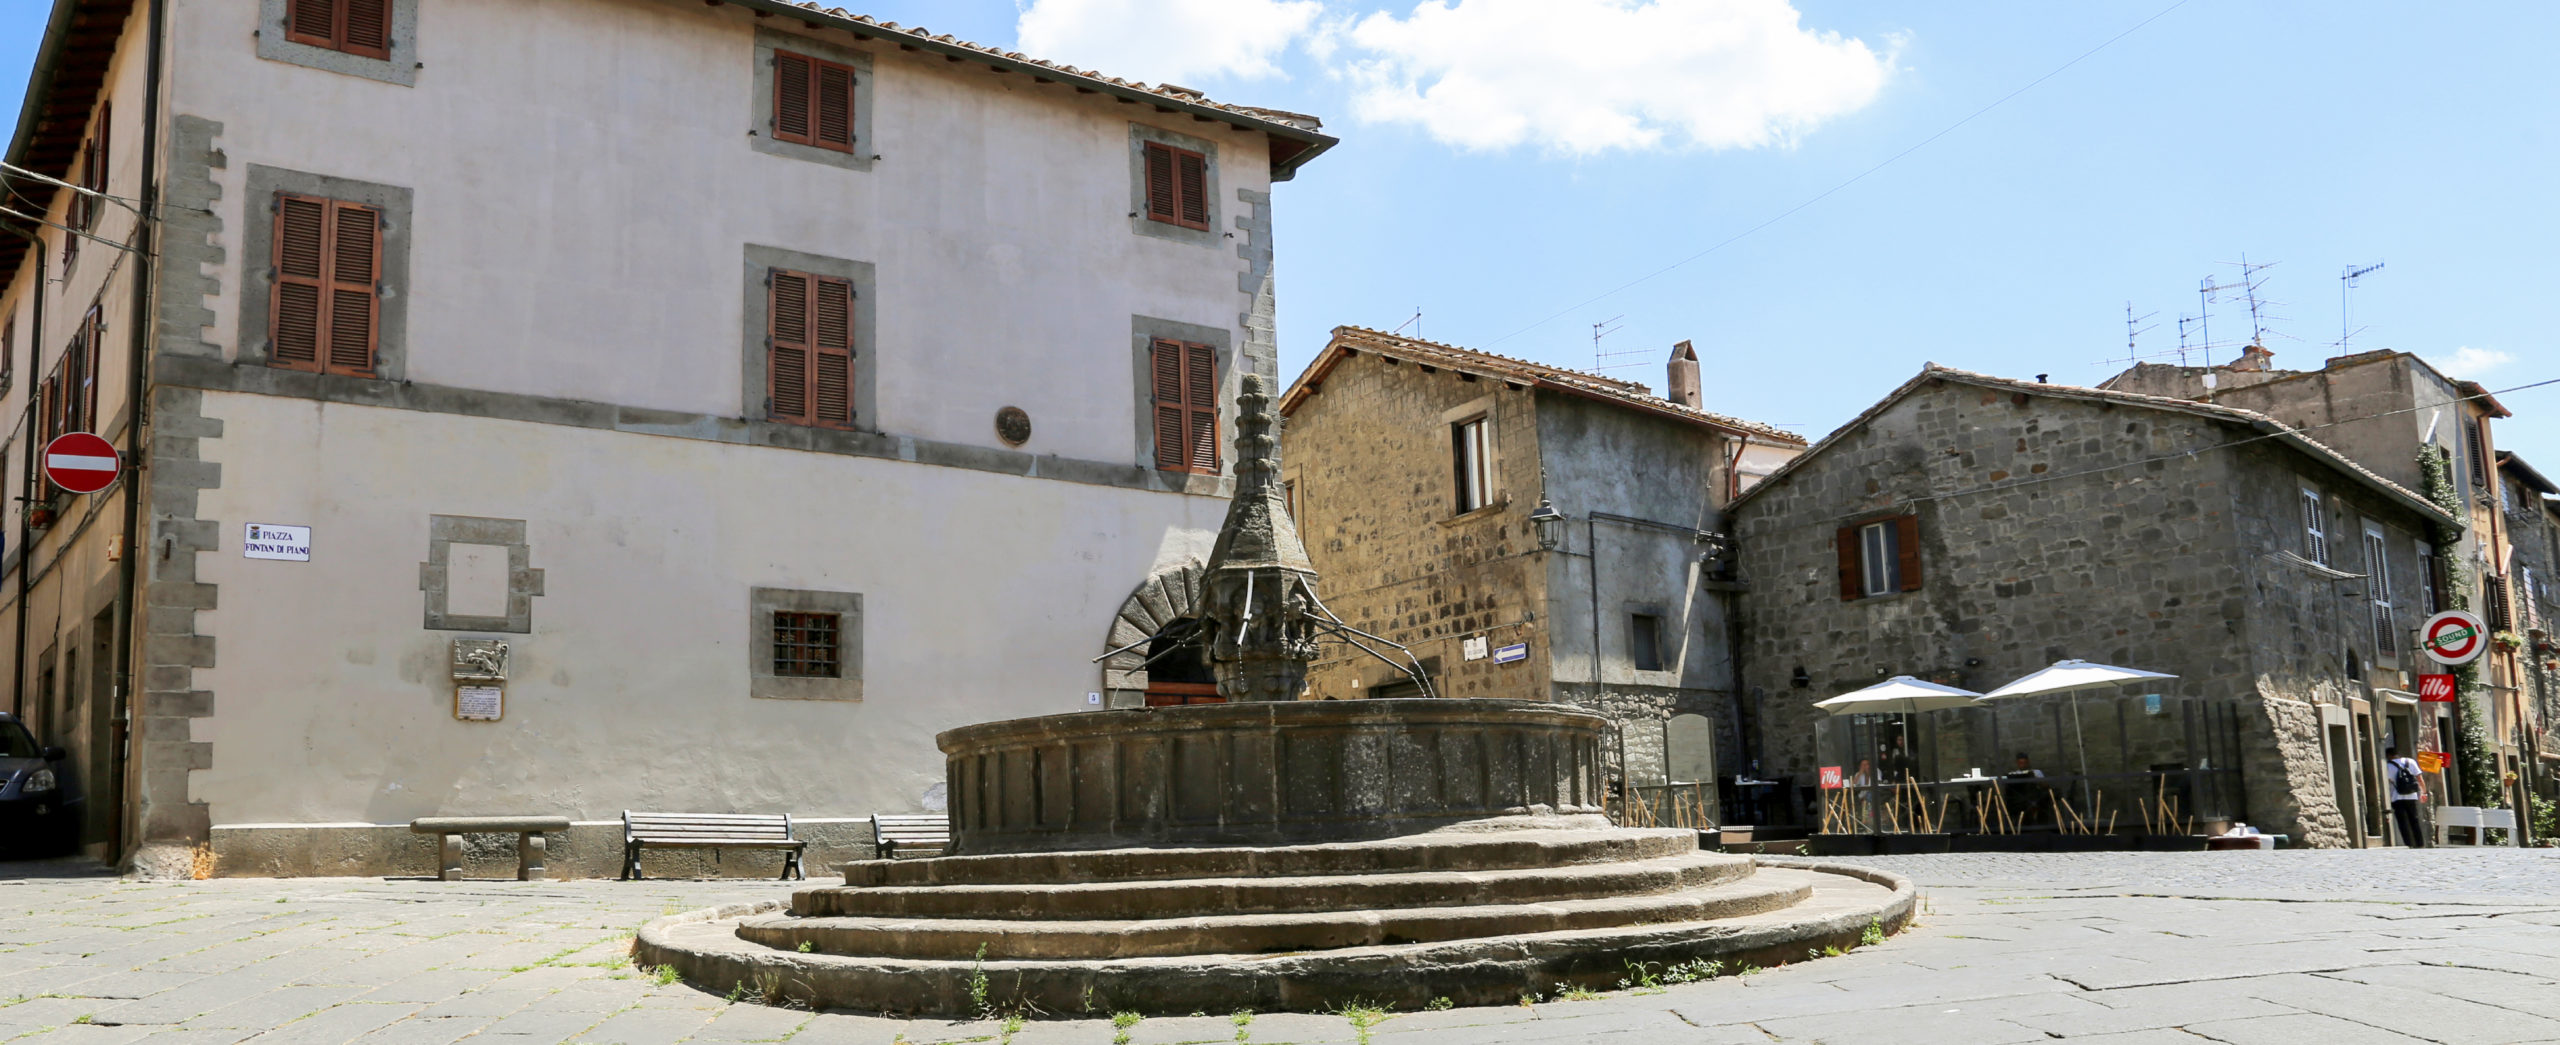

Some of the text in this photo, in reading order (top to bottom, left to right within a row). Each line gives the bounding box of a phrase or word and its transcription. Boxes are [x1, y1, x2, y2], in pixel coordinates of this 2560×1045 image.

[263, 531, 293, 541] PIAZZA
[245, 543, 310, 555] FONTAN DI PIANO
[2436, 629, 2468, 645] SOUND
[2420, 678, 2452, 700] illy
[1821, 770, 1841, 788] illy
